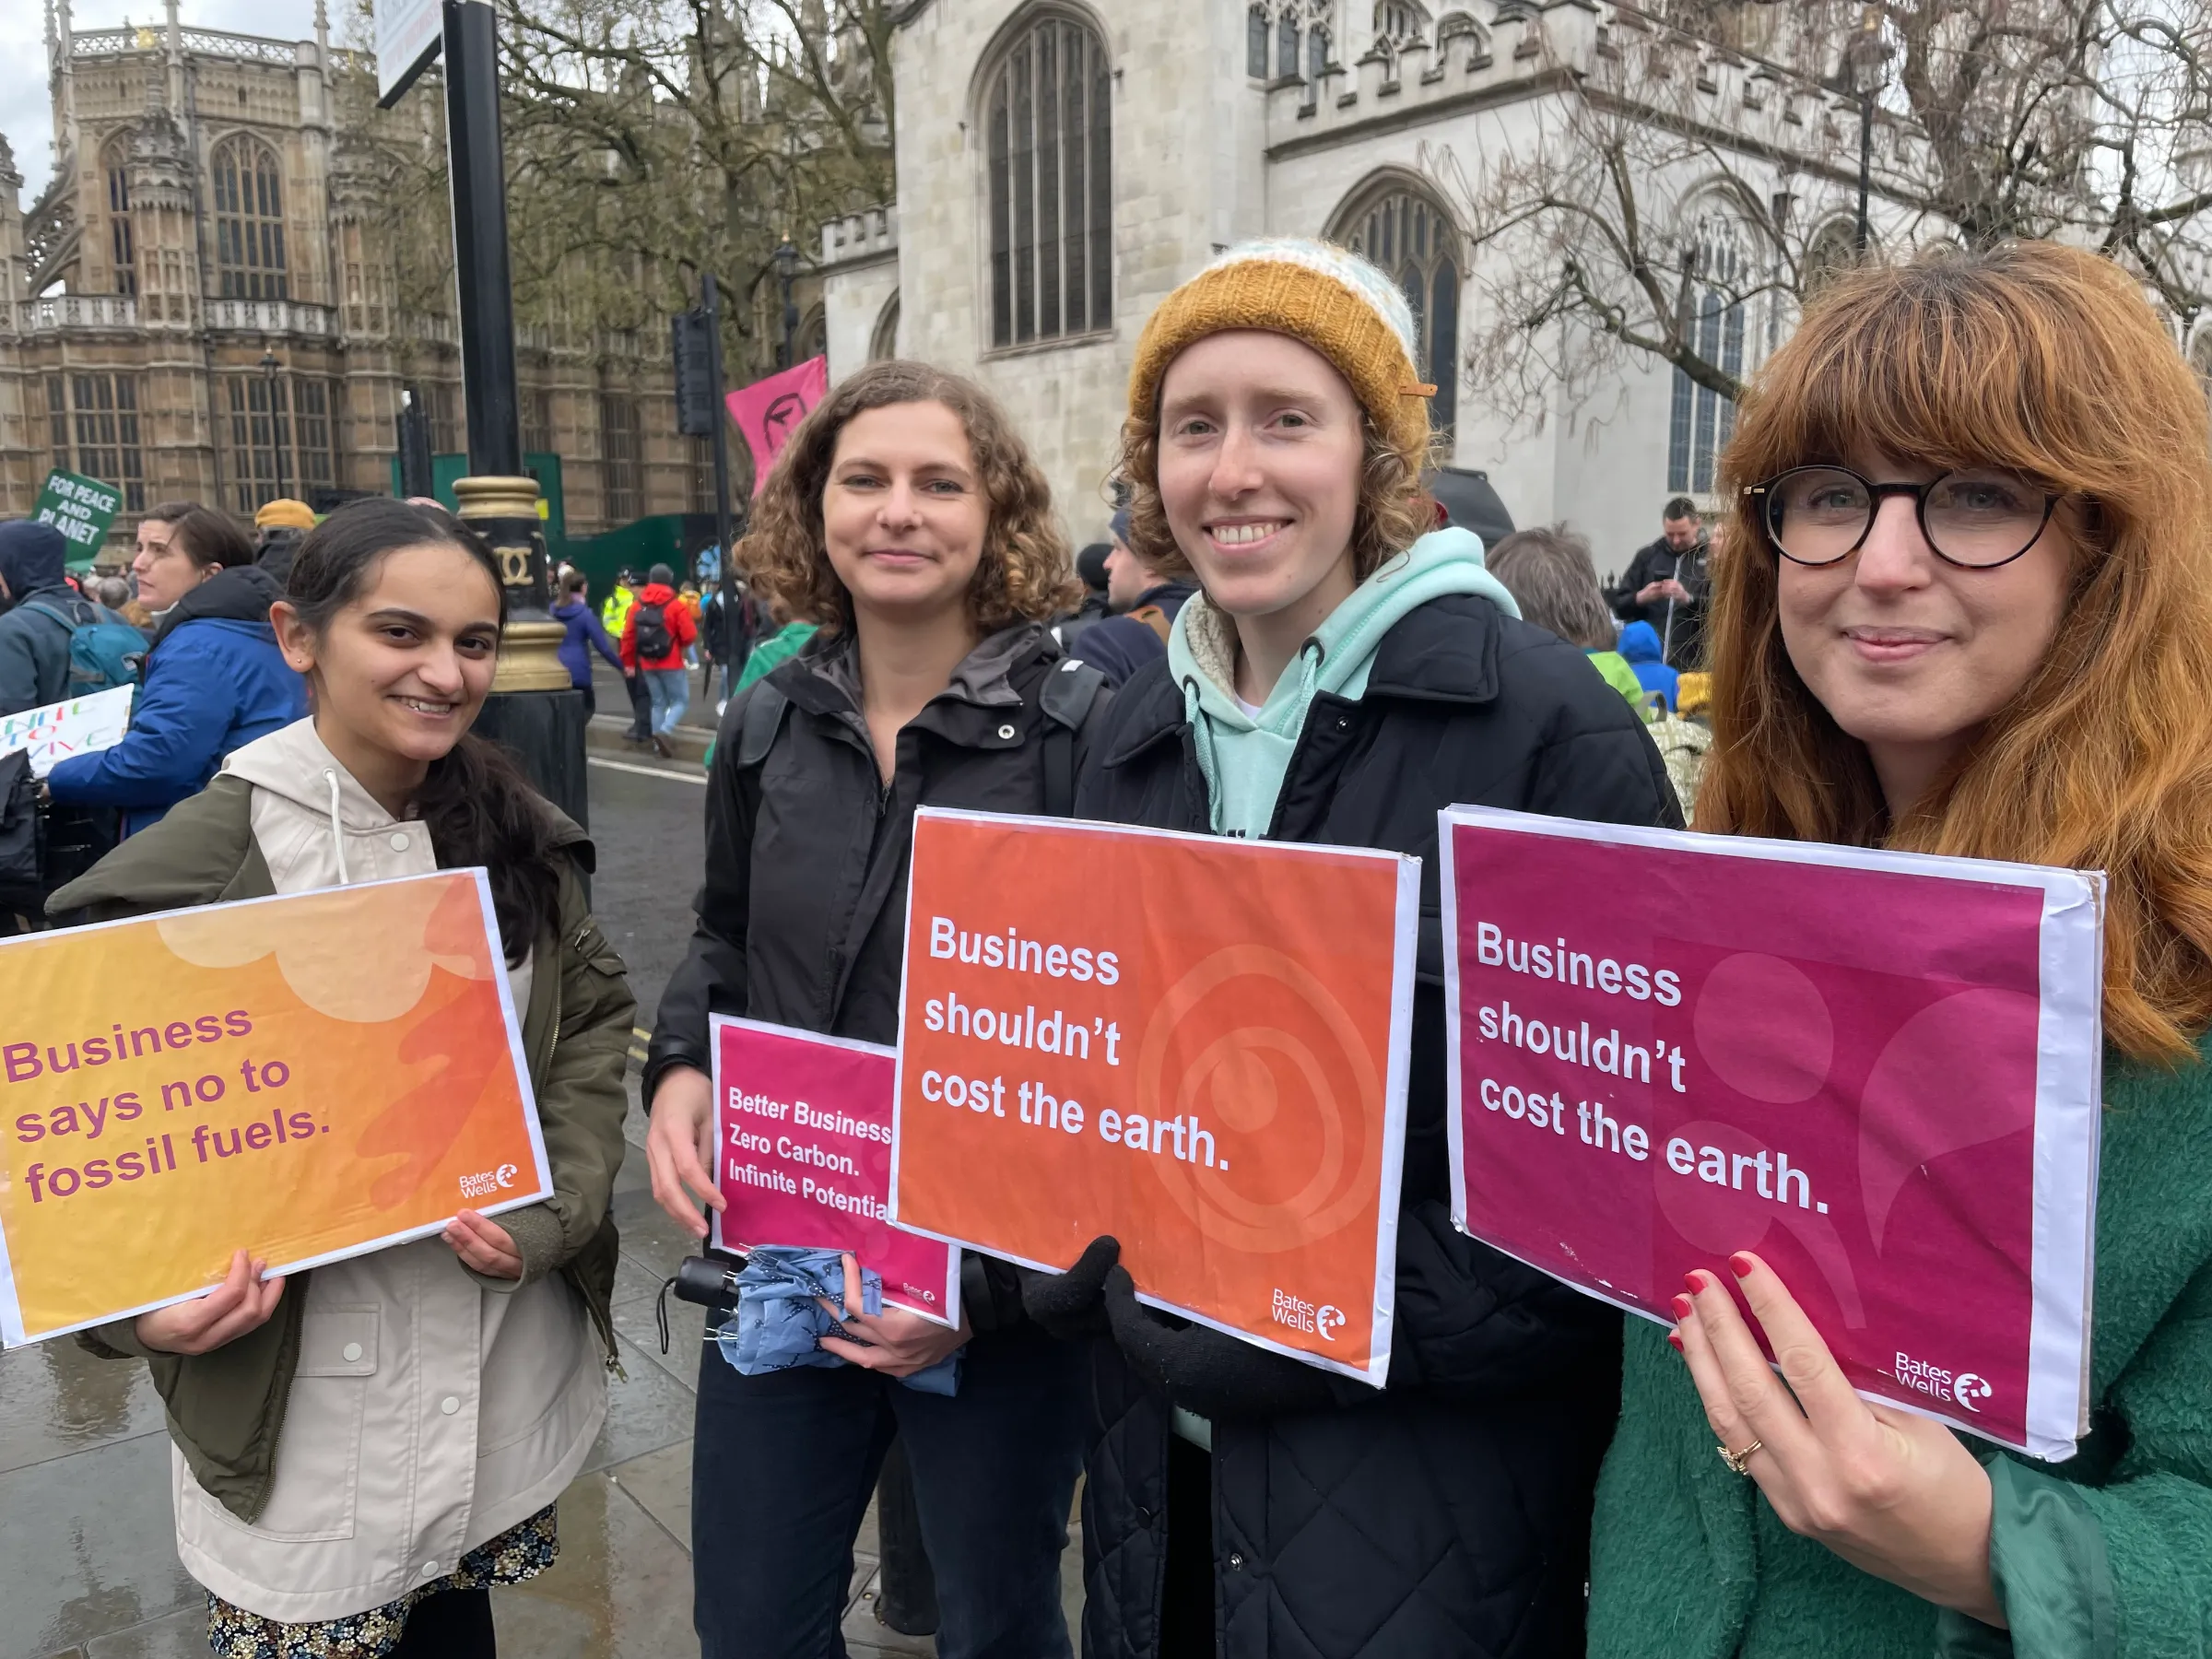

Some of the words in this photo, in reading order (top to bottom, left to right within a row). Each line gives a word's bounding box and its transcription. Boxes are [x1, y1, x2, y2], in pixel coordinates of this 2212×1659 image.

[48, 475, 75, 498] FOR
[74, 485, 116, 513] PEACE
[57, 499, 92, 521] AND
[929, 915, 1120, 986] Business
[1477, 921, 1682, 1007] Business
[2, 1009, 253, 1084] Business
[924, 992, 1121, 1066] shouldn’t
[1478, 1000, 1687, 1093] shouldn’t
[15, 1091, 144, 1144] says
[161, 1074, 226, 1112] no
[240, 1058, 290, 1093] to
[729, 1087, 790, 1121] Better
[794, 1100, 892, 1145] Business
[922, 1069, 1006, 1118] cost
[1018, 1080, 1085, 1135] the
[1099, 1108, 1229, 1171] earth.
[25, 1133, 177, 1204] fossil
[191, 1108, 330, 1163] fuels.
[729, 1123, 771, 1155] Zero
[777, 1135, 860, 1176] Carbon.
[1480, 1077, 1565, 1135] cost
[1576, 1100, 1650, 1161] the
[1666, 1136, 1829, 1215] earth.
[459, 1171, 495, 1189] Bates
[461, 1181, 498, 1199] Wells
[729, 1158, 797, 1195] Infinite
[802, 1176, 888, 1221] Potentia
[1272, 1304, 1314, 1334] Wells
[1273, 1288, 1314, 1316] Bates
[1895, 1369, 1951, 1402] Wells
[1896, 1351, 1952, 1385] Bates
